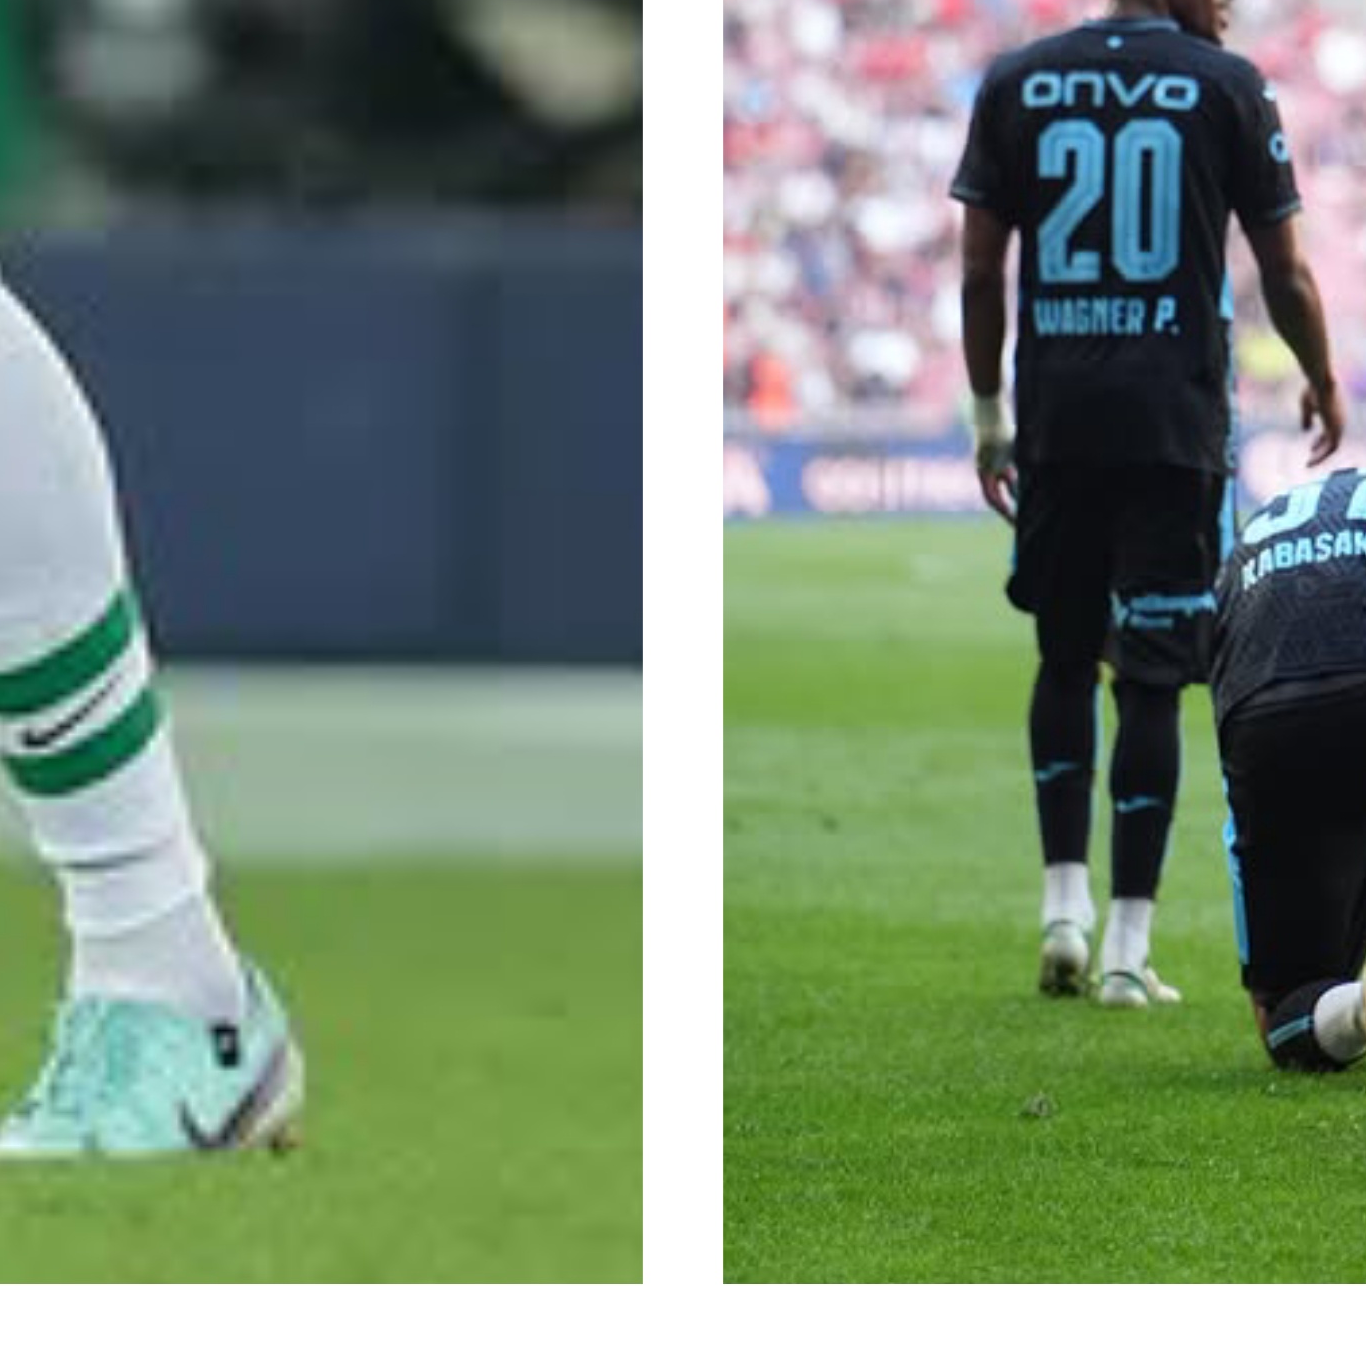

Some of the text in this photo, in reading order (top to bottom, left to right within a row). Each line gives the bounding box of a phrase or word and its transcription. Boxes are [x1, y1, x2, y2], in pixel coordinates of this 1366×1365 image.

[1021, 71, 1201, 112] onvo
[1036, 117, 1183, 284] 20
[1034, 297, 1147, 337] WAGNER
